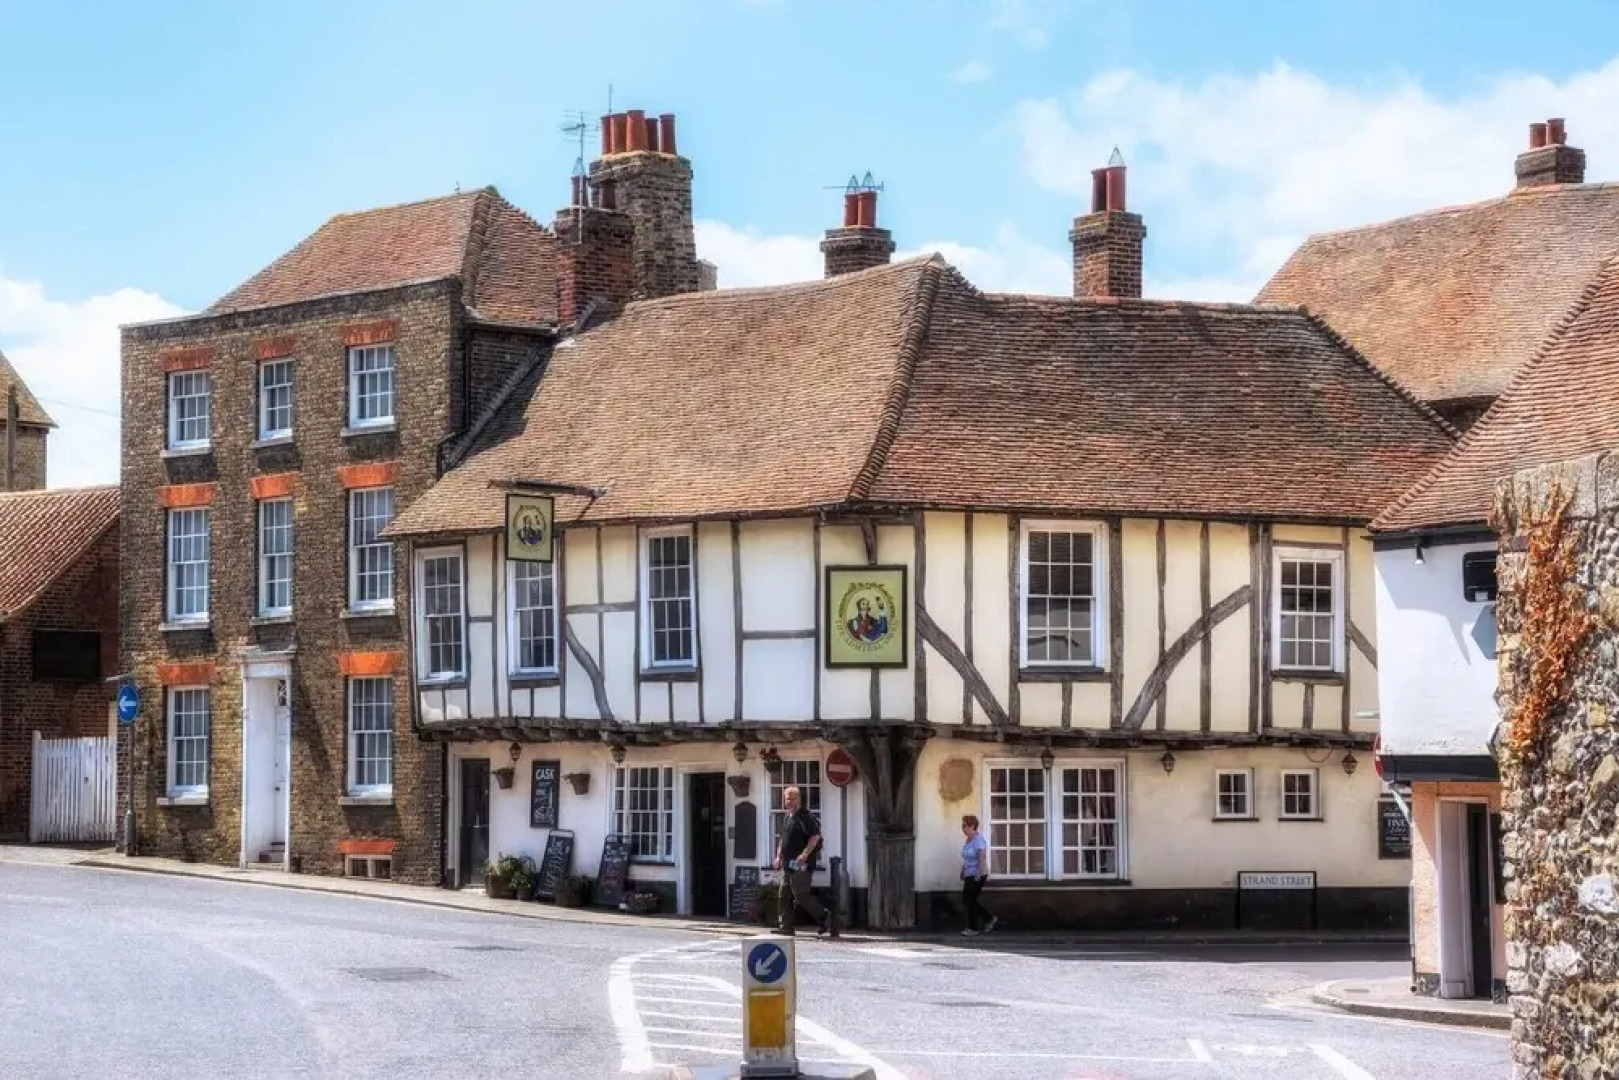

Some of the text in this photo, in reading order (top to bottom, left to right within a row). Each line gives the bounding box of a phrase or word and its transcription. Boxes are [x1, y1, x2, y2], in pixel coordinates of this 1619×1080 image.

[535, 768, 556, 780] CASK
[1243, 875, 1311, 886] STRAND STREET
